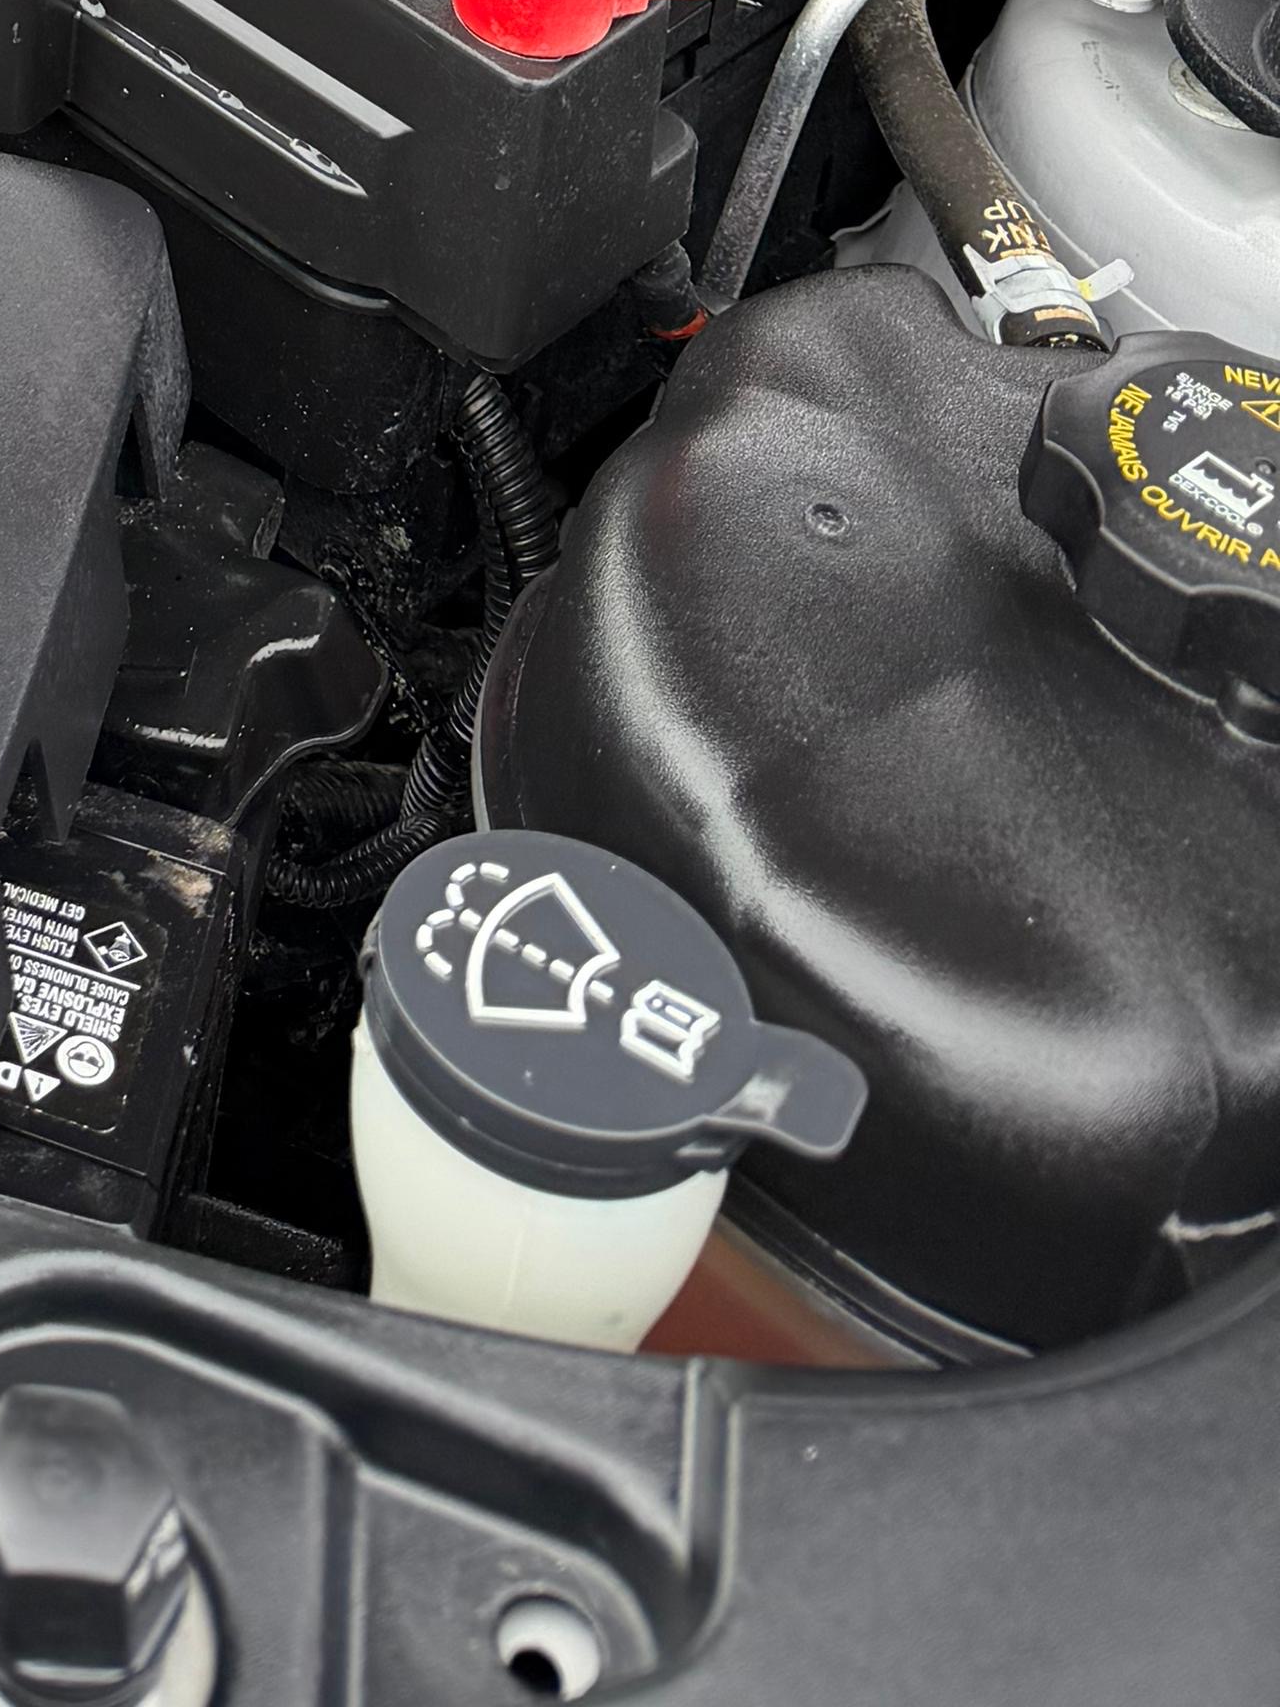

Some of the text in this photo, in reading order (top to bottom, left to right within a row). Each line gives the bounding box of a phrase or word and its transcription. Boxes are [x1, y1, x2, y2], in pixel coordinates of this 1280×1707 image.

[983, 198, 1035, 221] UP
[1176, 372, 1233, 412] SURGE
[1177, 381, 1217, 408] TANK
[1224, 364, 1280, 395] NEV
[1113, 383, 1152, 416] NE
[1182, 398, 1213, 420] PSI
[1108, 407, 1149, 483] JAMAIS
[1141, 485, 1252, 565] OUVRIR
[2, 882, 86, 922] GET MEDICAL
[4, 923, 76, 959] FLUSH EYE
[44, 919, 79, 942] WITH
[24, 960, 91, 992] BLINDNESS
[12, 973, 127, 1025] EXPLOSIVE GA
[90, 979, 130, 1006] CAUSE
[63, 1012, 122, 1043] SHIELD
